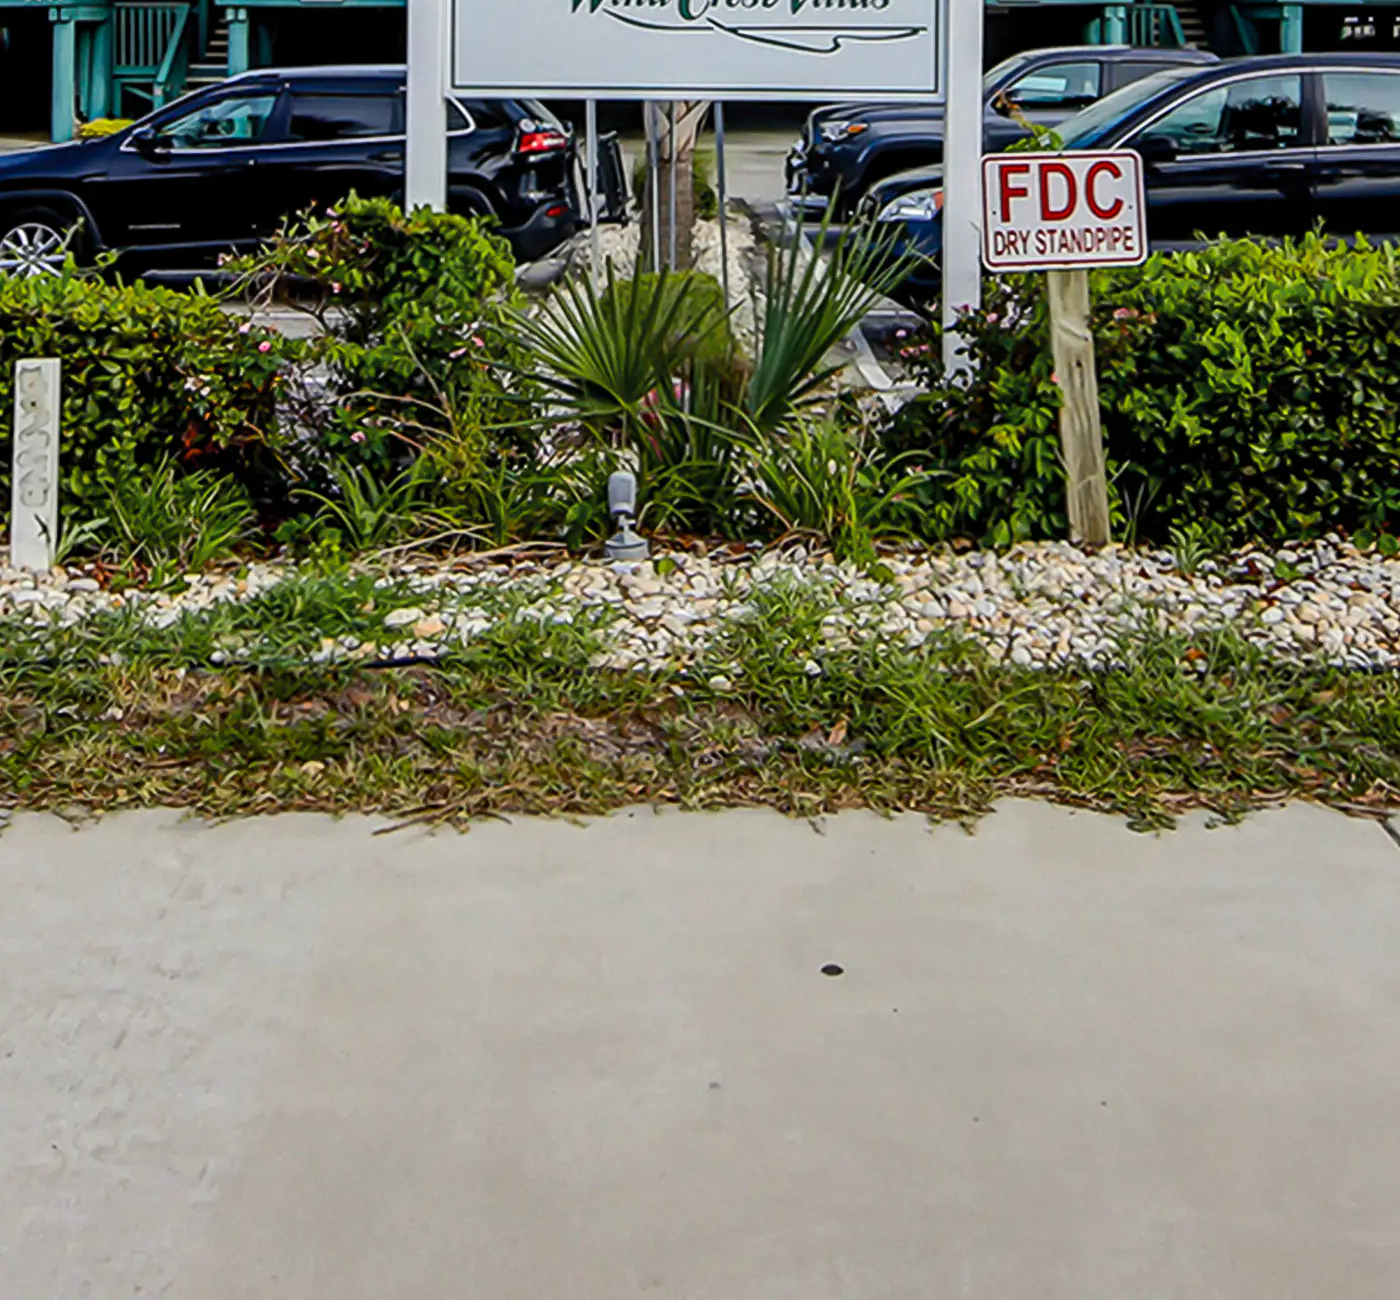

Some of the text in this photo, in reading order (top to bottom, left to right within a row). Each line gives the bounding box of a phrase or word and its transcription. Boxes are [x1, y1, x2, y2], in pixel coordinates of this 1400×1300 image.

[999, 160, 1125, 223] FDC
[993, 226, 1135, 257] DRY STANDPIPE
